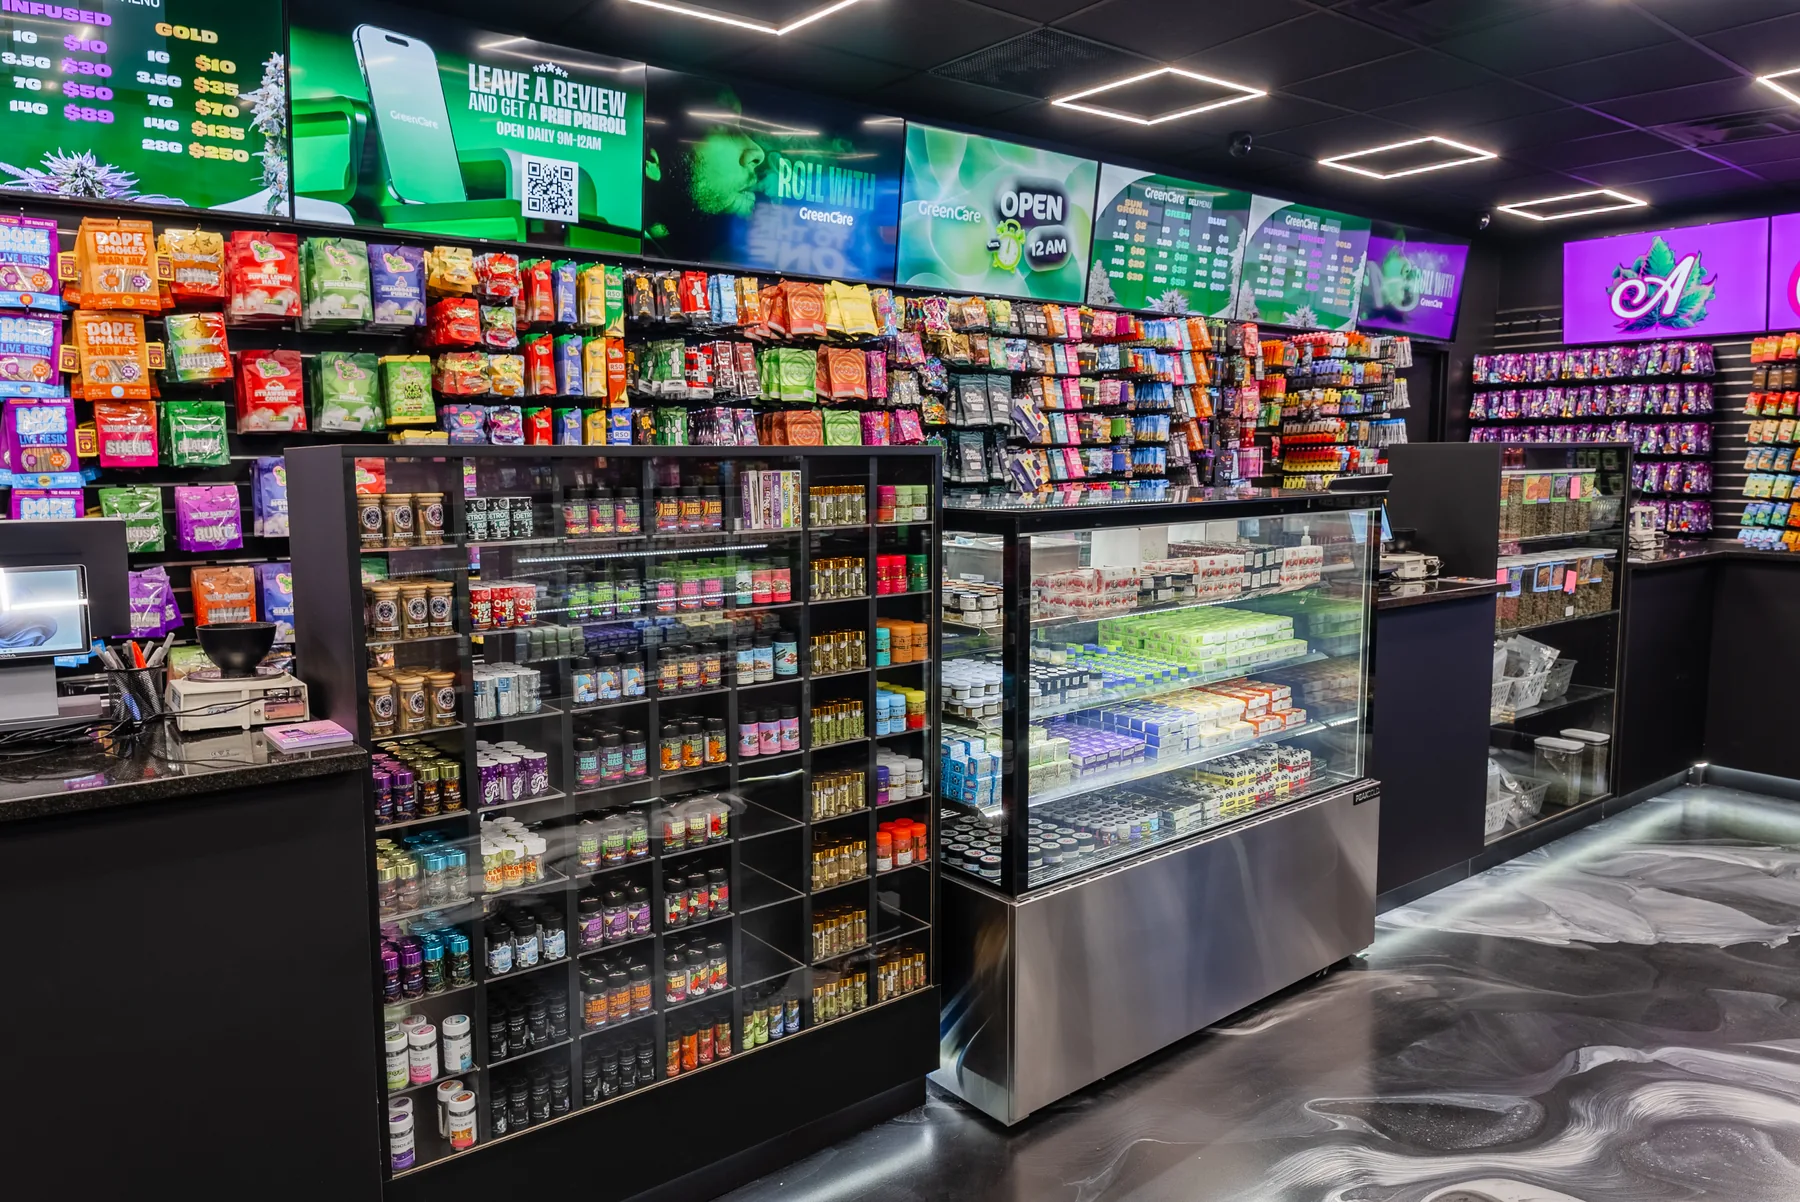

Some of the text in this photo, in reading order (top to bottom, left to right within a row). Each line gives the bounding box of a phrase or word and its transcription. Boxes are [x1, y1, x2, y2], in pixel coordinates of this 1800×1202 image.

[2, 0, 112, 26] INFUSED
[13, 30, 108, 54] 1G $10
[155, 22, 218, 44] GOLD
[1, 52, 112, 78] 3.5G $30
[147, 50, 236, 74] 1G $10
[13, 77, 114, 100] 7G $50
[136, 71, 239, 96] 3.5G $35
[468, 63, 626, 117] LEAVE A REVIEW
[10, 100, 114, 124] 14G $89
[147, 94, 240, 118] 7G $70
[469, 92, 626, 136] AND GET A FREE PREROLL
[143, 117, 245, 140] 14G $135
[390, 110, 438, 129] GreenCare
[497, 121, 524, 138] OPEN
[527, 126, 554, 144] DAILY
[142, 139, 249, 162] 28G $250
[778, 158, 876, 211] ROLL WITH
[1145, 187, 1184, 204] GreenCare
[799, 207, 853, 226] GreenCare
[918, 201, 981, 223] GreenCare
[1000, 191, 1062, 221] OPEN
[1165, 209, 1191, 220] GREEN
[1208, 216, 1226, 226] BLUE
[1285, 215, 1318, 230] GreenCare
[0, 226, 47, 244] DOPE
[96, 232, 144, 246] DOPE
[97, 246, 145, 255] SMOKES
[1420, 298, 1443, 308] GreenCare
[87, 322, 134, 336] DOPE
[1, 345, 51, 356] LIVE RESIN
[88, 336, 138, 345] SMOKES
[19, 408, 65, 423] DOPE
[20, 434, 67, 444] LIVE RESIN
[23, 499, 73, 514] DOPE
